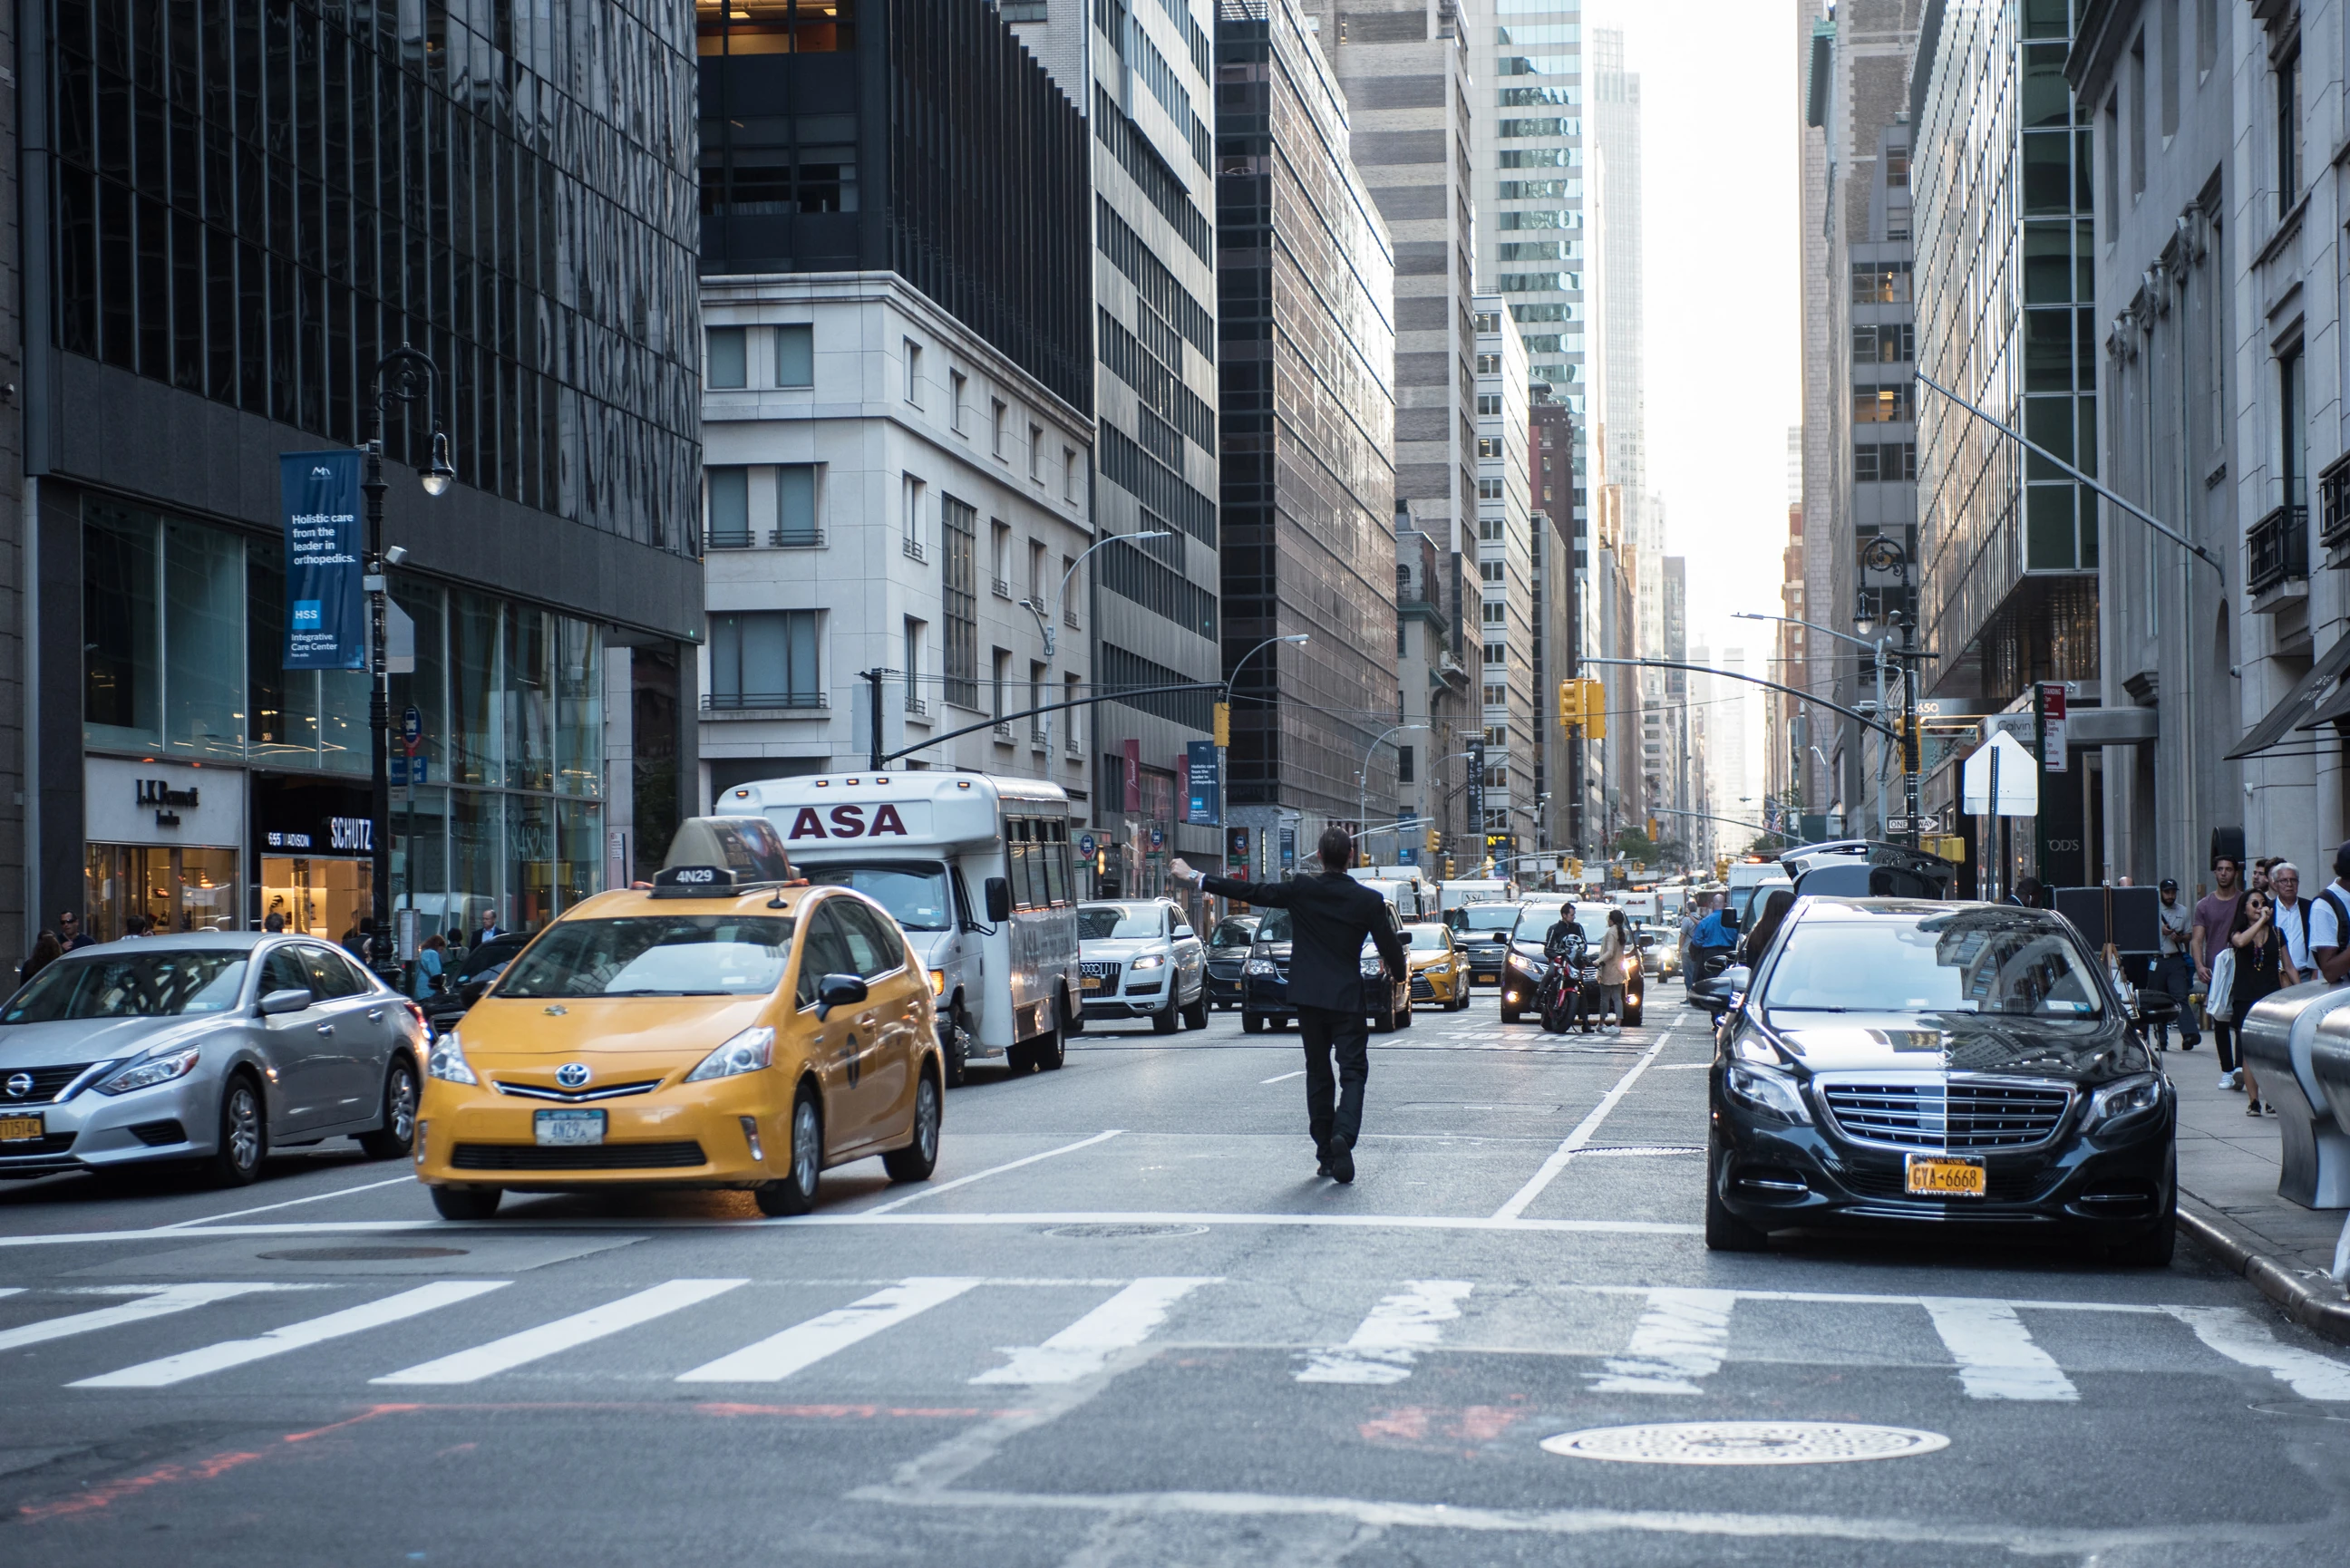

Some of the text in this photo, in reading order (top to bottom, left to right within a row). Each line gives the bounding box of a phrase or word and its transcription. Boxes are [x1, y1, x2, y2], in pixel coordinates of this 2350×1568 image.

[292, 514, 329, 524] Holistic
[293, 528, 335, 537] from the
[293, 541, 335, 551] leader in
[294, 554, 355, 566] orthopedics.
[295, 610, 317, 619] HSS
[291, 634, 333, 642] Integrative
[311, 643, 337, 651] Center
[1917, 702, 1939, 713] 650
[1998, 720, 2031, 731] Calvin
[788, 804, 908, 840] ASA
[1890, 820, 1908, 828] ONE
[268, 831, 281, 847] 655
[331, 817, 372, 850] SCHUTZ
[2047, 839, 2080, 852] OD'S
[675, 870, 713, 883] 4N29
[1946, 1168, 1977, 1187] 6668
